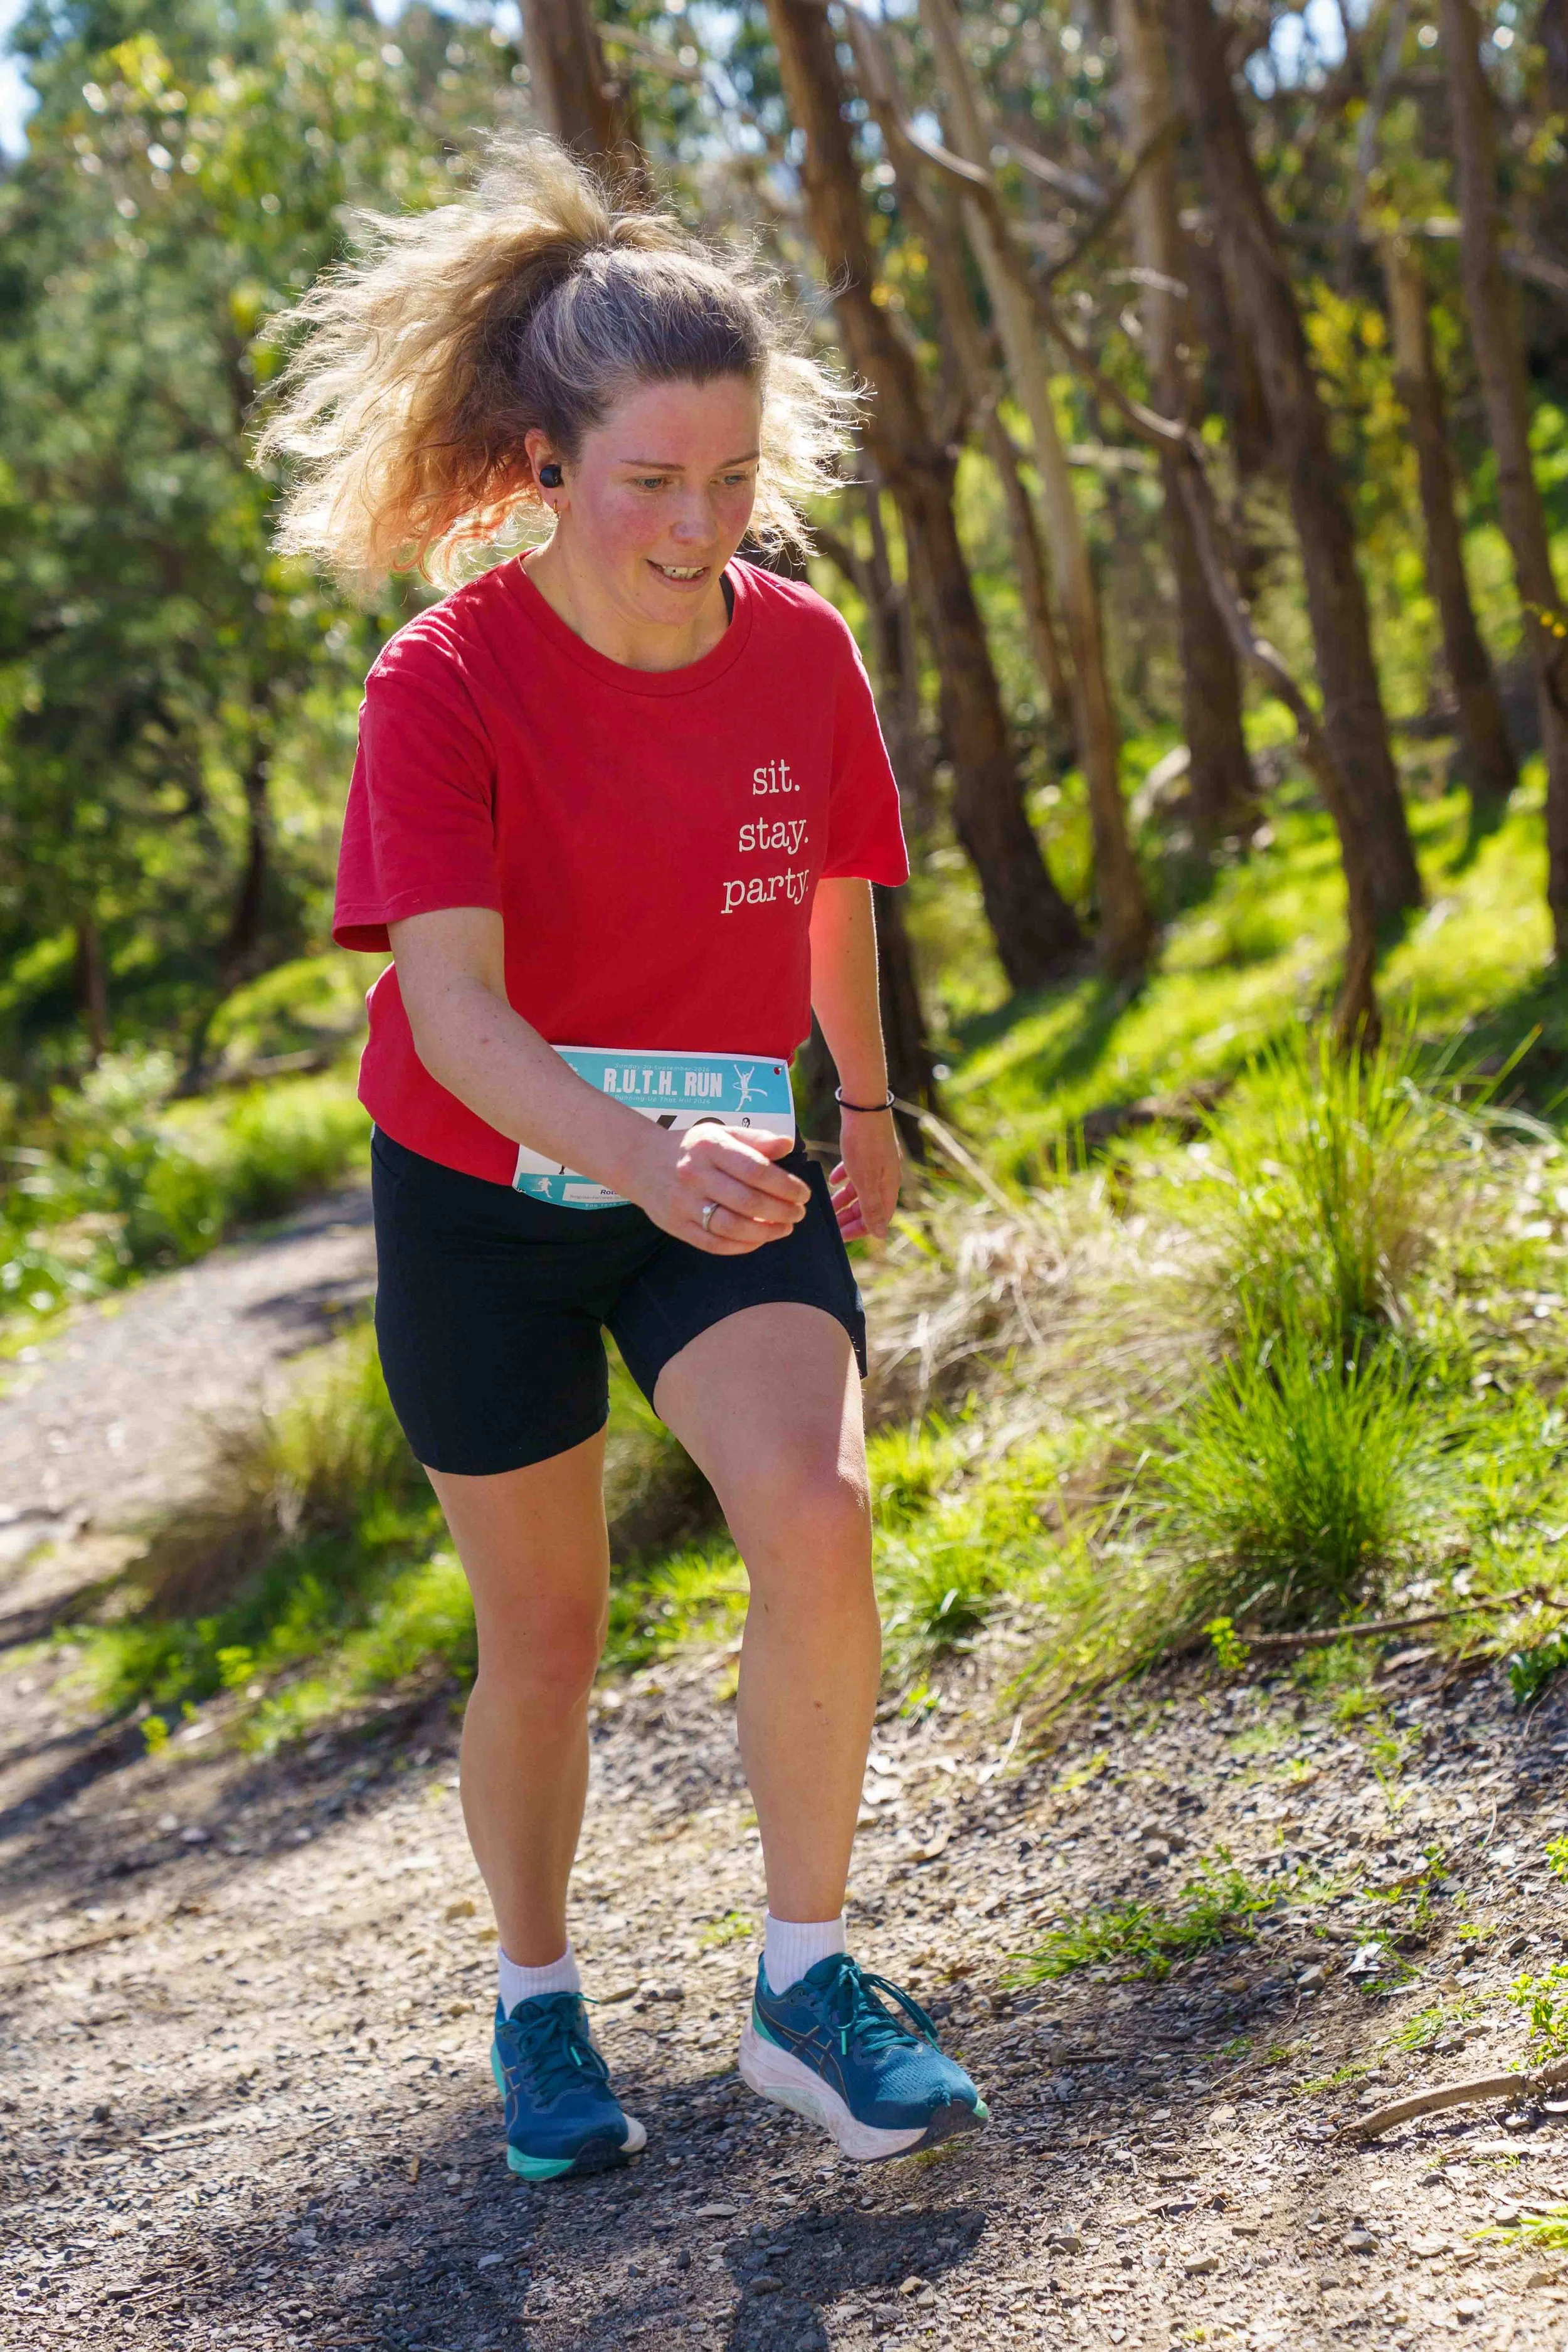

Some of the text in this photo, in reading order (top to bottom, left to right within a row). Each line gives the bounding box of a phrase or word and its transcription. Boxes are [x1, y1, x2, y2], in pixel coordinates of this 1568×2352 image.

[753, 759, 800, 795] sit.
[739, 817, 808, 854] stay.
[721, 867, 809, 914] party.
[603, 1068, 722, 1097] R.U.T.H. RUN
[614, 1094, 644, 1102] Running
